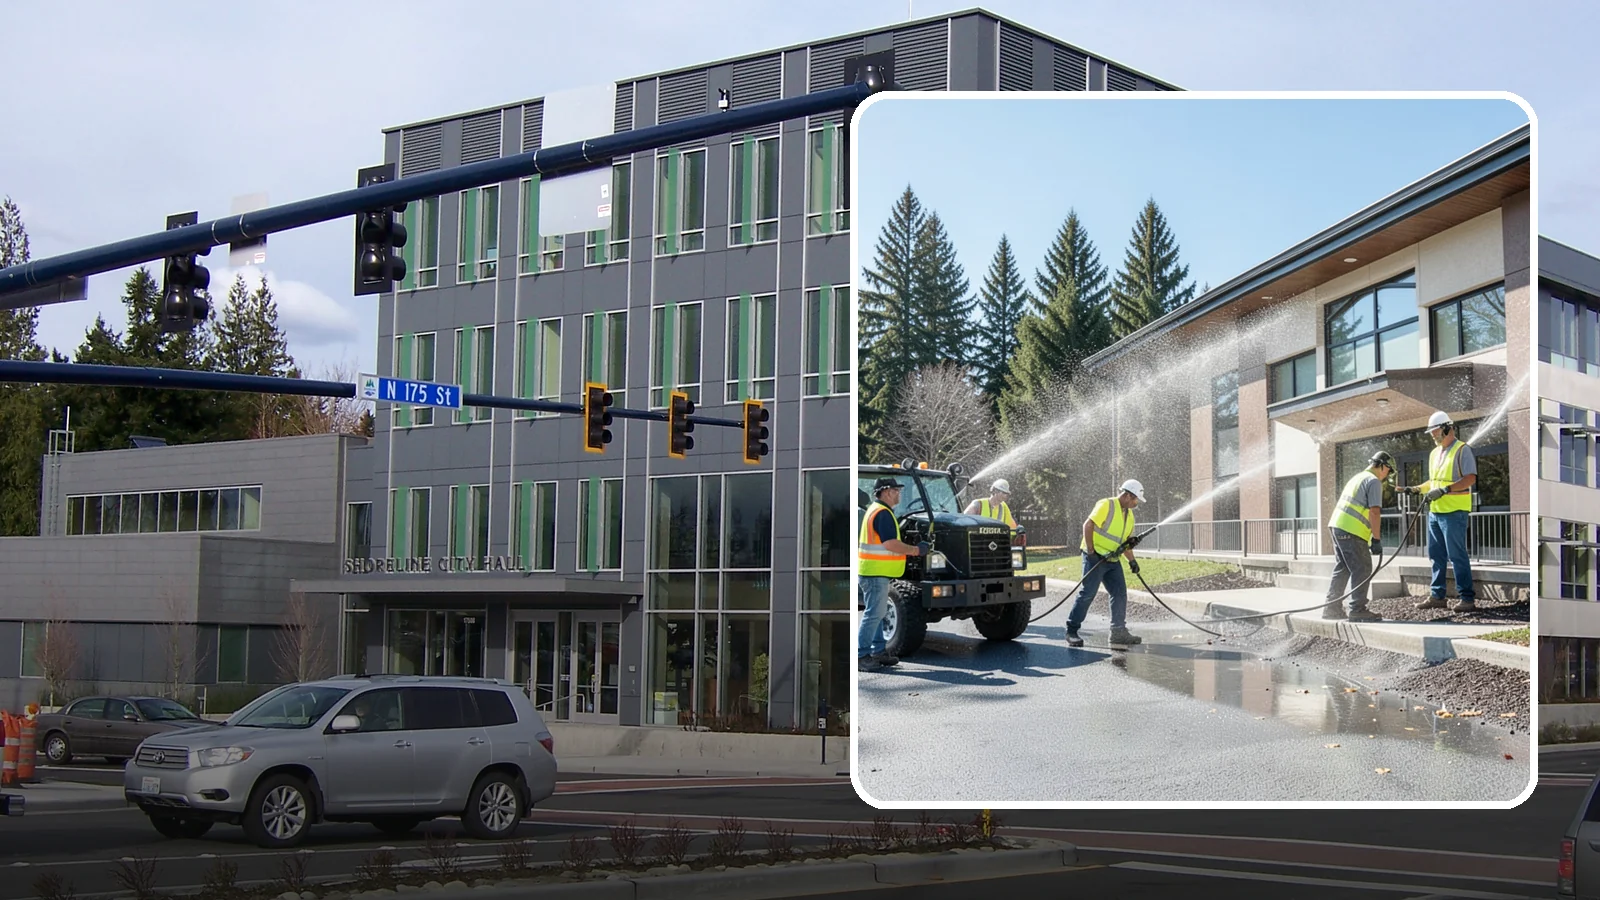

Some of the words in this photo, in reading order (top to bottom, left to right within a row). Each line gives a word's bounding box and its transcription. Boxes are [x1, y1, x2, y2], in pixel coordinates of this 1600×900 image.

[387, 380, 396, 399] N
[405, 382, 428, 403] 175
[436, 386, 451, 406] St
[343, 556, 431, 574] SHORELINE
[438, 556, 475, 573] CITY
[484, 555, 525, 572] HALL
